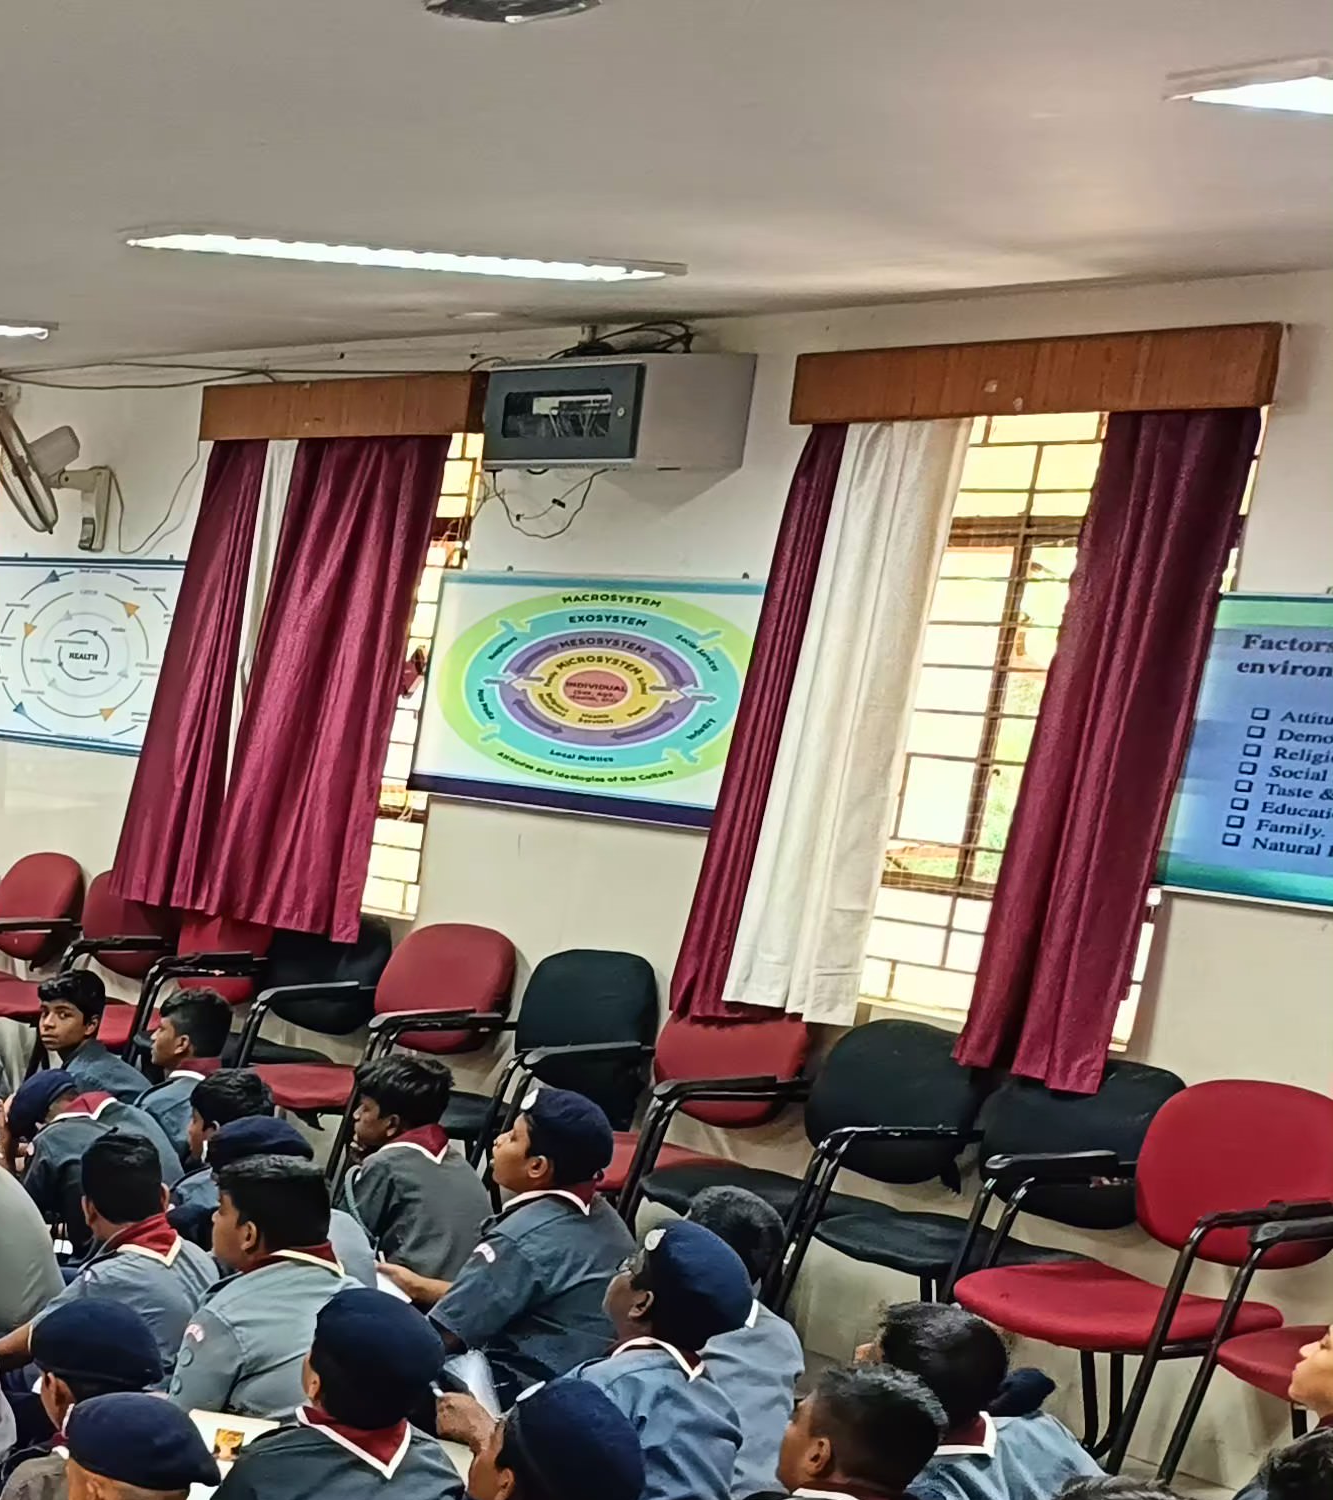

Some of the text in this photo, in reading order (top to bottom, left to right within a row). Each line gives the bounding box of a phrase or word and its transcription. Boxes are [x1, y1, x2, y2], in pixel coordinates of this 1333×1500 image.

[561, 593, 662, 608] MACROSYSTEM
[568, 614, 648, 628] EXOSYSTEM
[559, 637, 647, 653] MESOSYSTEM
[556, 655, 644, 675] MICROSYSTEM
[564, 681, 628, 693] INDIVIDUAL
[1273, 747, 1333, 766] Religi
[1268, 764, 1329, 782] Social
[1264, 782, 1315, 799] Taste
[1260, 800, 1333, 820] Educati
[1255, 818, 1326, 840] Family.
[1250, 836, 1322, 856] Natural
